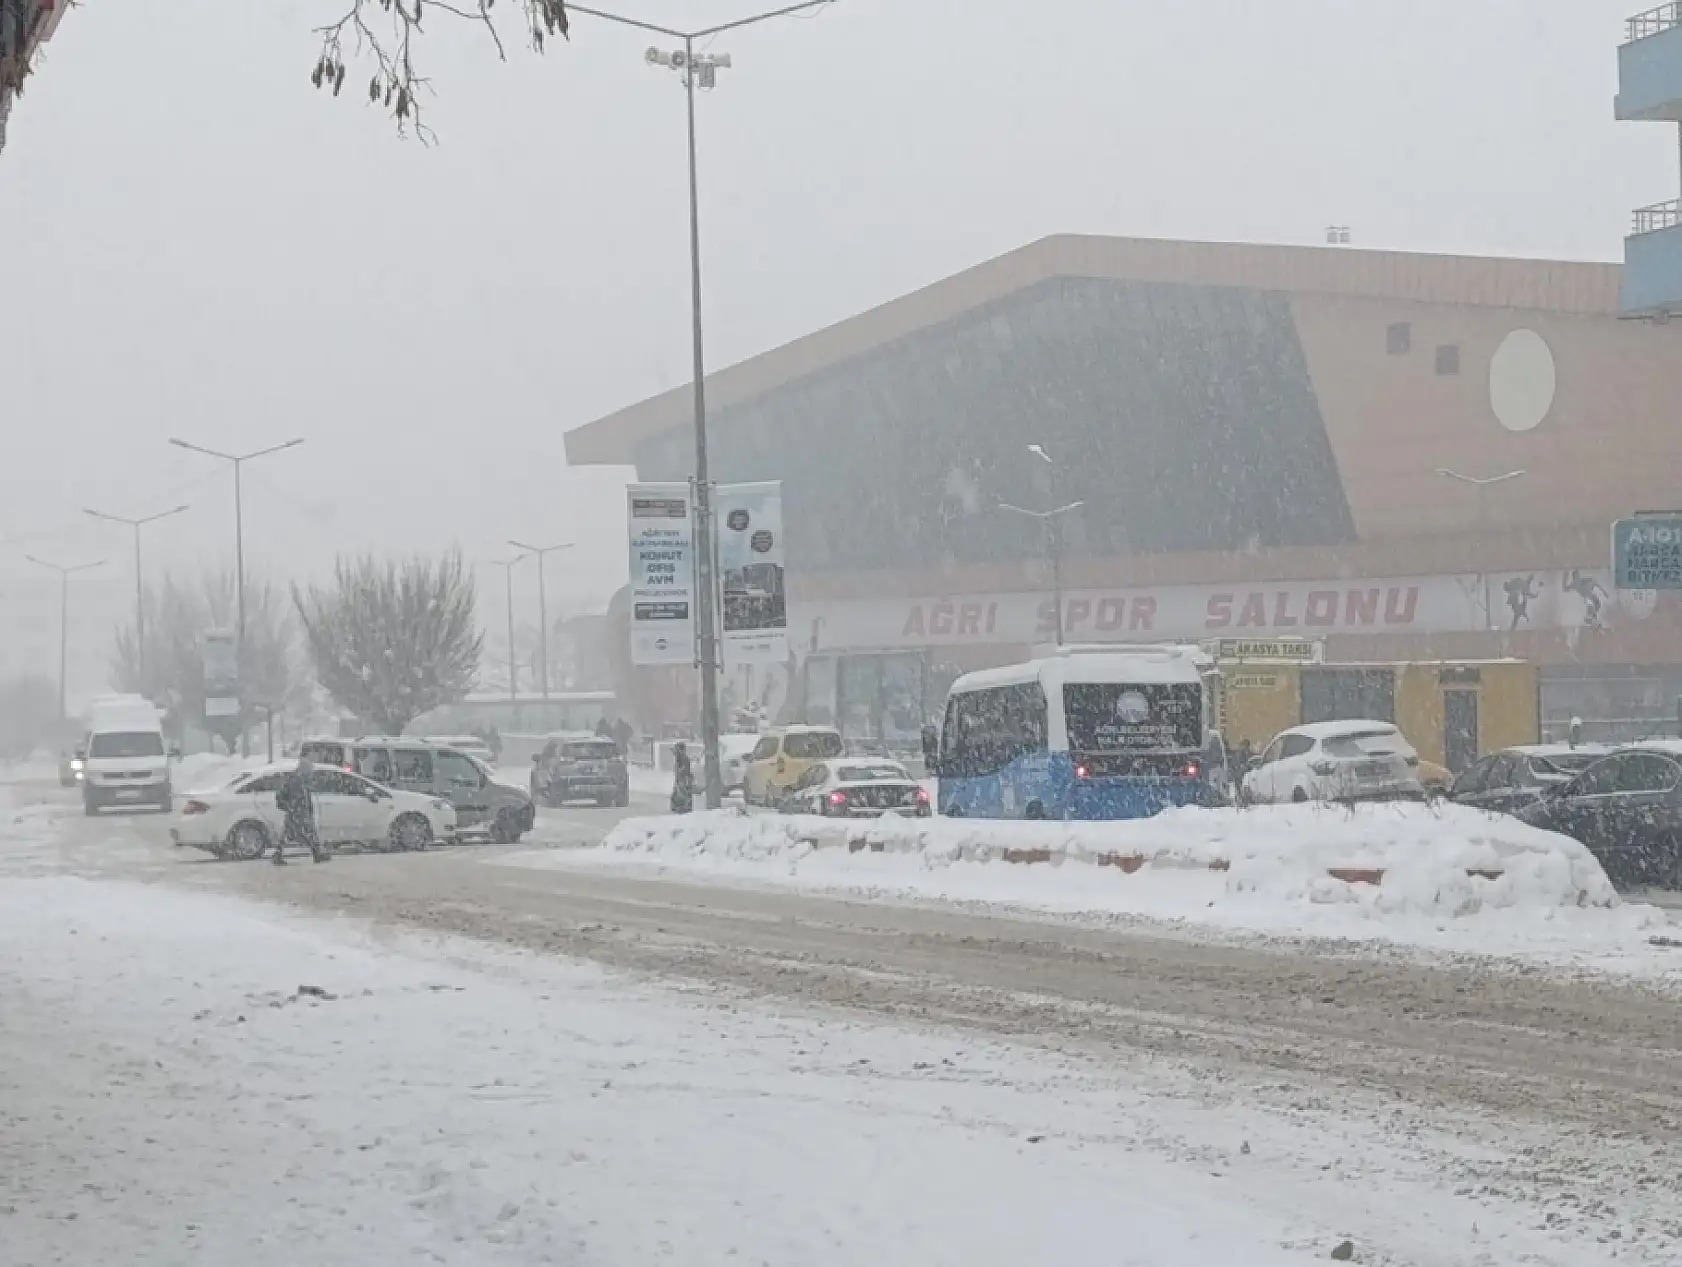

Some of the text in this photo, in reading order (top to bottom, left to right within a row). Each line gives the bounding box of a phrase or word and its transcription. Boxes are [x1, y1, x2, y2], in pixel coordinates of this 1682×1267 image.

[640, 551, 683, 560] KONUT
[646, 575, 674, 584] AVM
[903, 586, 1420, 636] AĞRI SPOR SALONU
